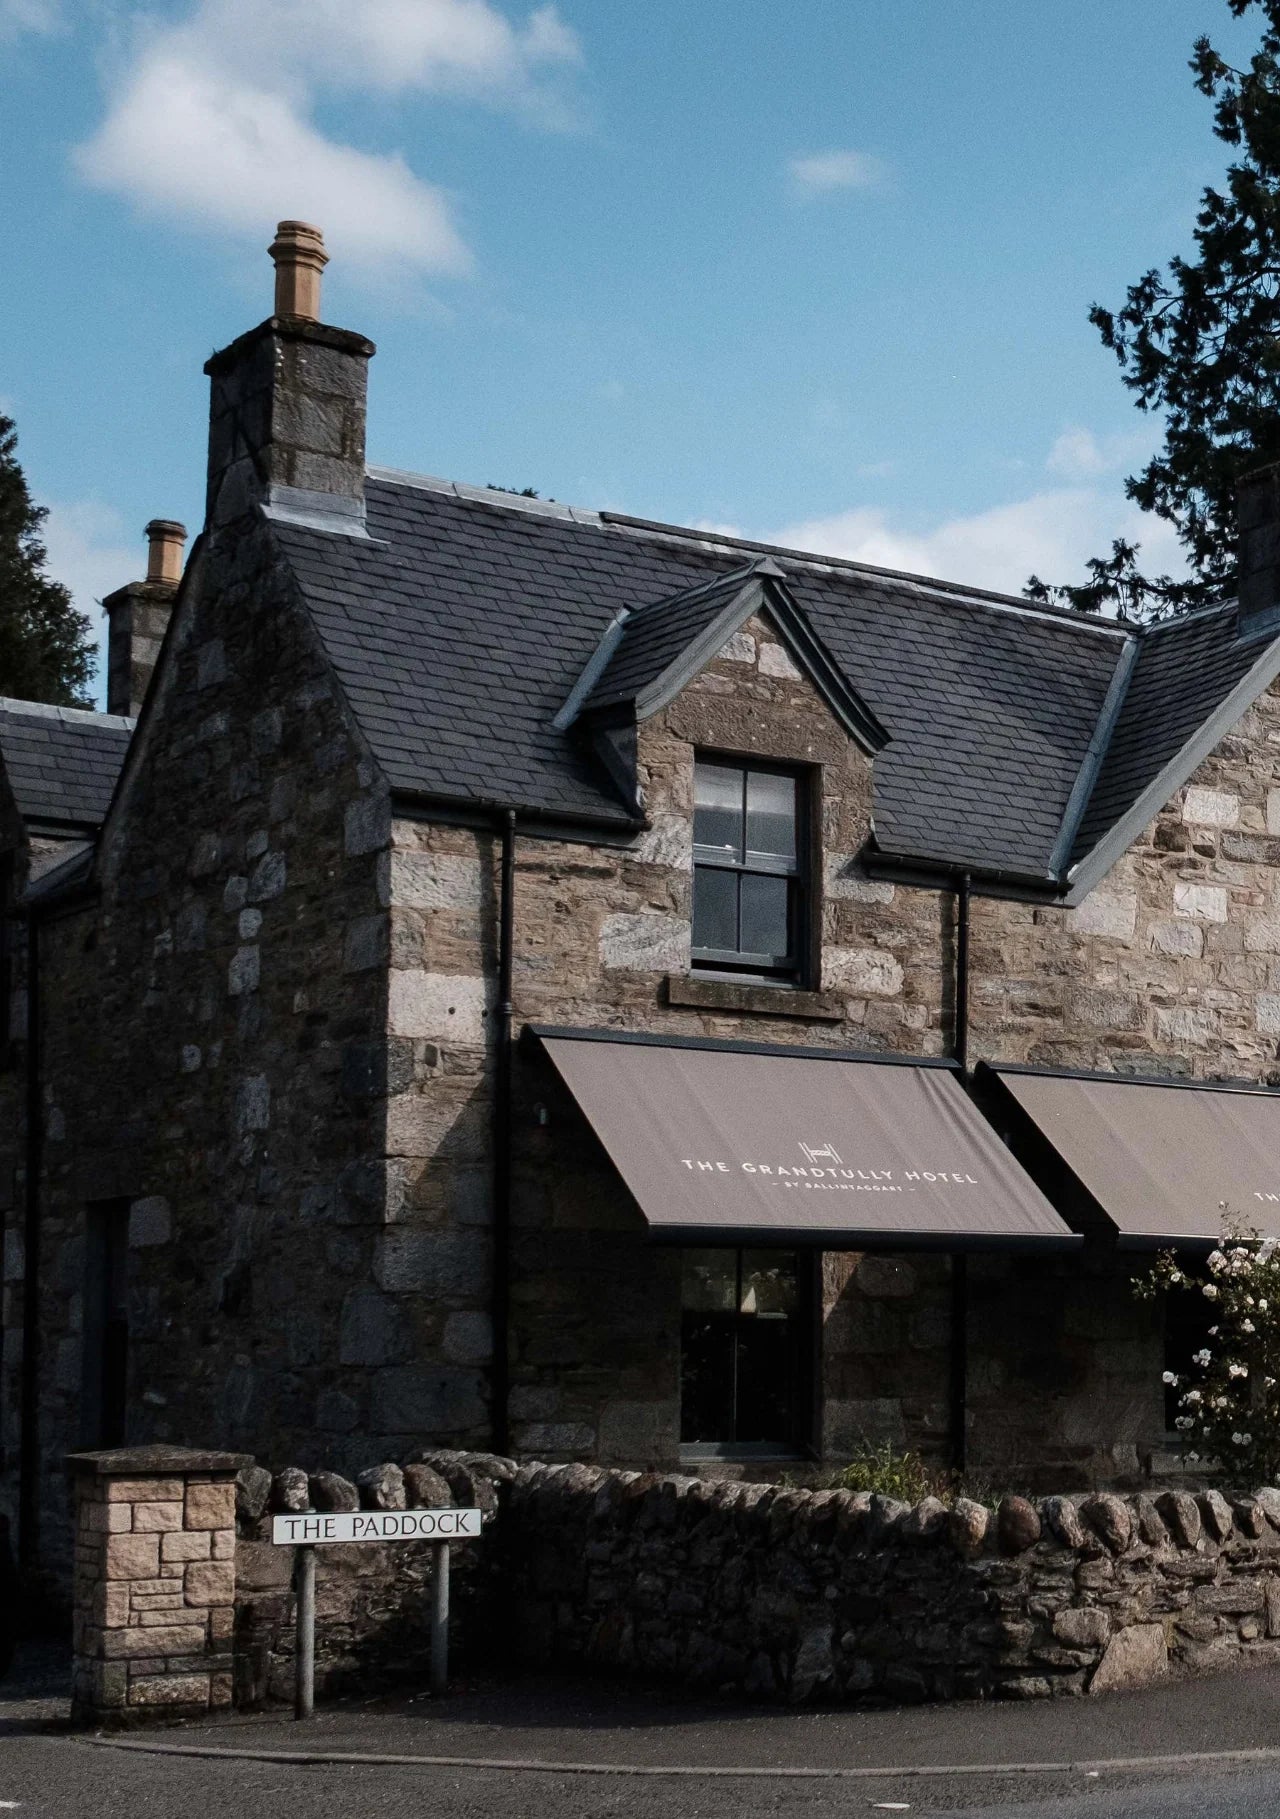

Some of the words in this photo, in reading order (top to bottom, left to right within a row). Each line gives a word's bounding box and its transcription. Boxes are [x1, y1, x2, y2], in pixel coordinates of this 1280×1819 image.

[681, 1159, 730, 1172] THE
[741, 1162, 893, 1181] GRANDTULLY
[905, 1171, 978, 1184] HOTEL
[805, 1182, 902, 1191] BALLINTAGGART
[284, 1518, 337, 1539] THE
[352, 1513, 471, 1537] PADDOCK
